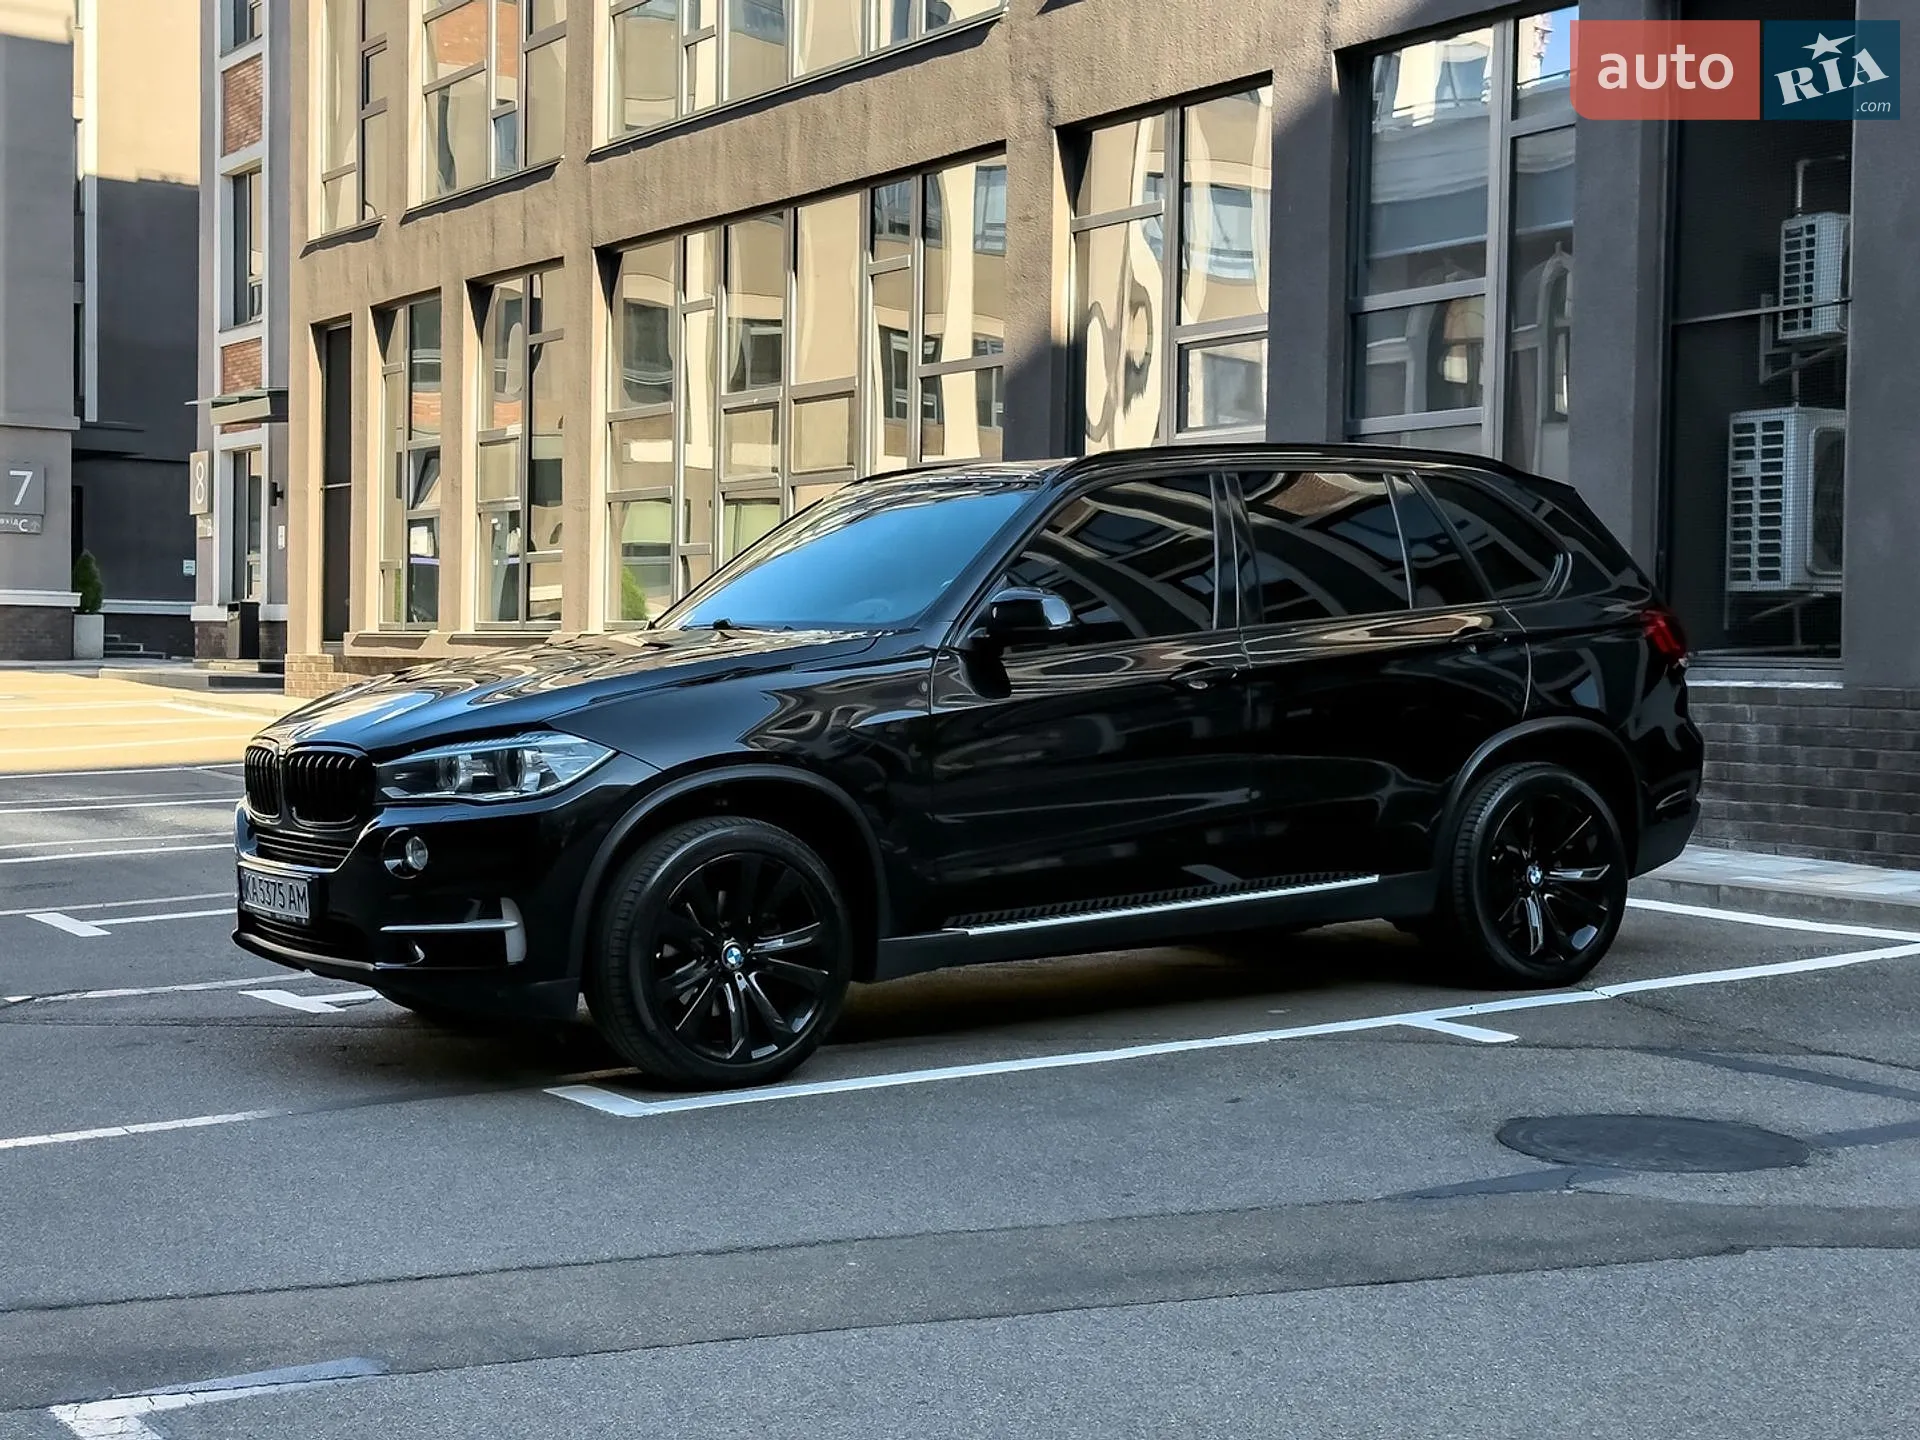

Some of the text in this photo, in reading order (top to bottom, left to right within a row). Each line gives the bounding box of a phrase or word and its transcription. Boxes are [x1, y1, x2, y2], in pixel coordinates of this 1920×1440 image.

[9, 470, 33, 506] 7
[195, 461, 205, 504] 8
[288, 884, 308, 913] AM
